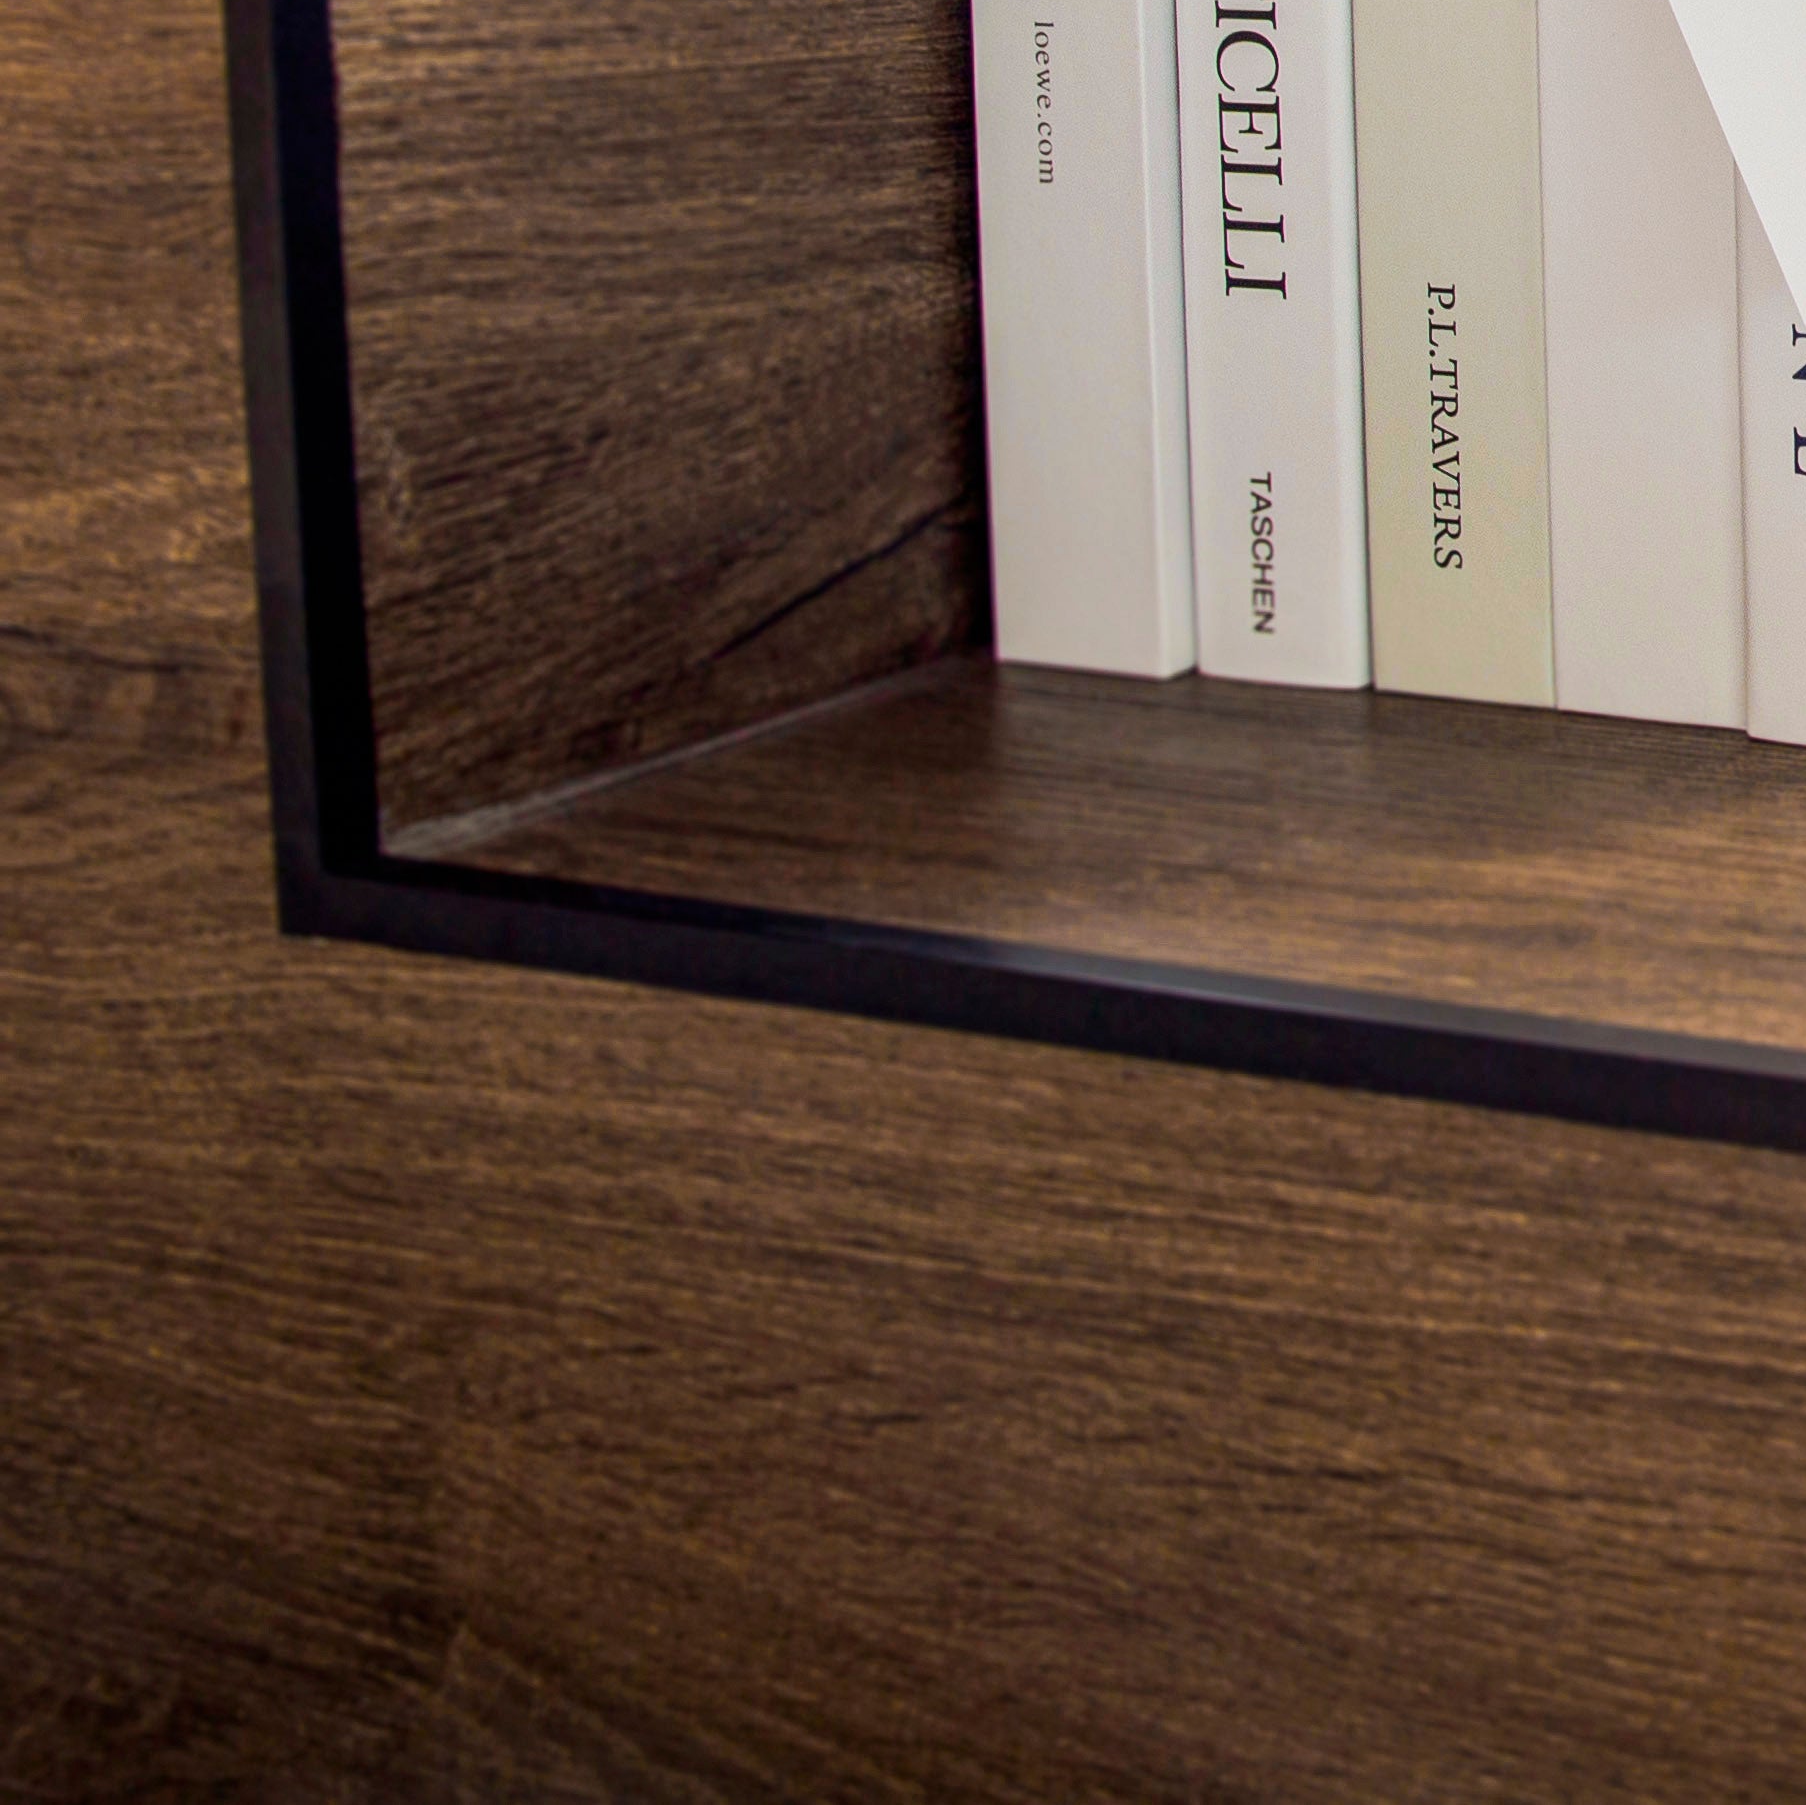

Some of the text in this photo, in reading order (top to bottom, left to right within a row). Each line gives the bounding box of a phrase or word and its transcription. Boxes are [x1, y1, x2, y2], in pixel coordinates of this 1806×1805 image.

[1033, 20, 1055, 185] loewe.com
[1427, 281, 1463, 571] P.L.TRAVERS
[1249, 470, 1275, 635] TASCHEN
